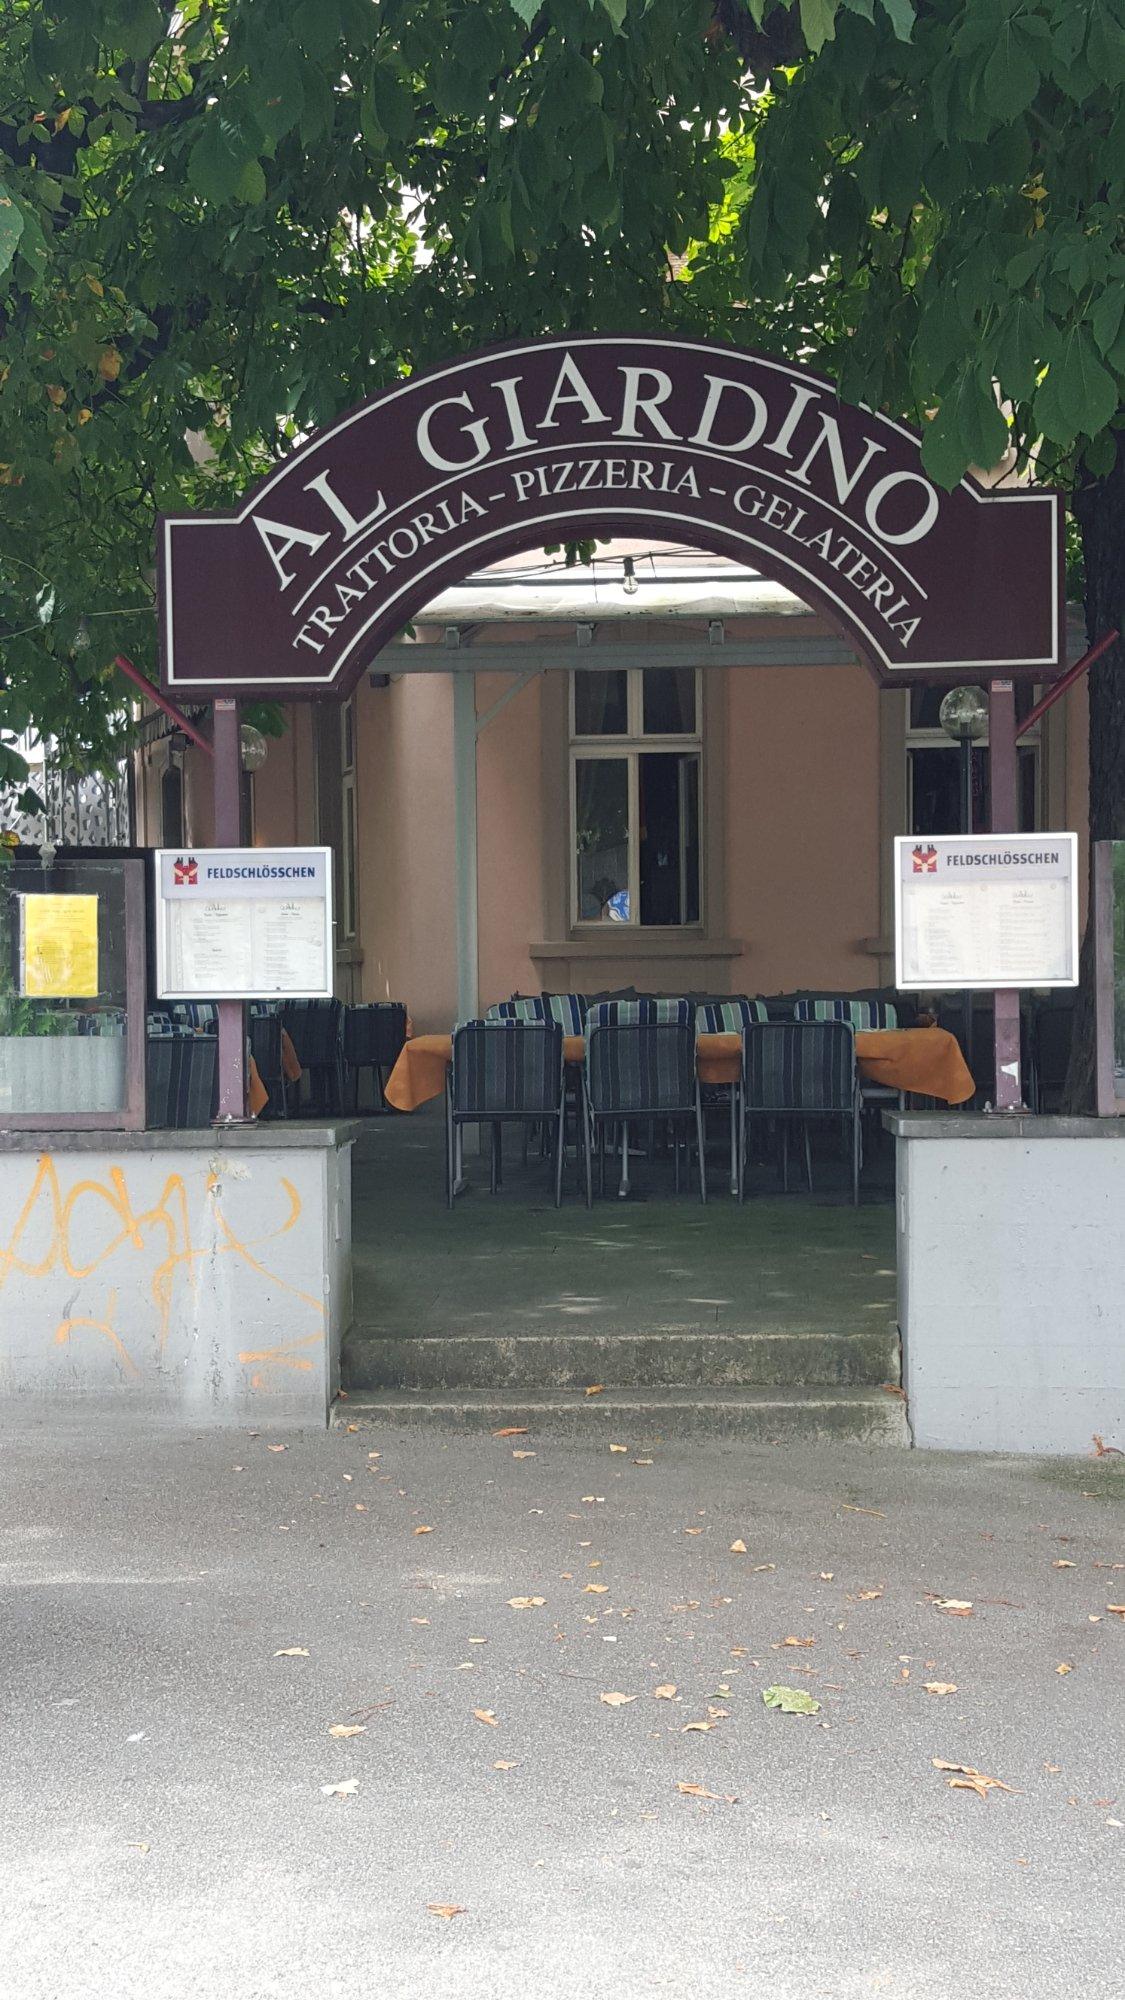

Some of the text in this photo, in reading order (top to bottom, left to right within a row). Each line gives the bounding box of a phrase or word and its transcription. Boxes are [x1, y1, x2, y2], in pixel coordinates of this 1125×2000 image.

[252, 352, 939, 591] AL GIARDINO
[293, 491, 488, 655] TRATTORIA
[511, 458, 700, 502] PIZZERIA
[734, 484, 922, 648] GELATERIA
[207, 865, 315, 879] FELDSCHLÖSSCHEN
[946, 851, 1059, 867] FELDSCHLÖSSCHEN
